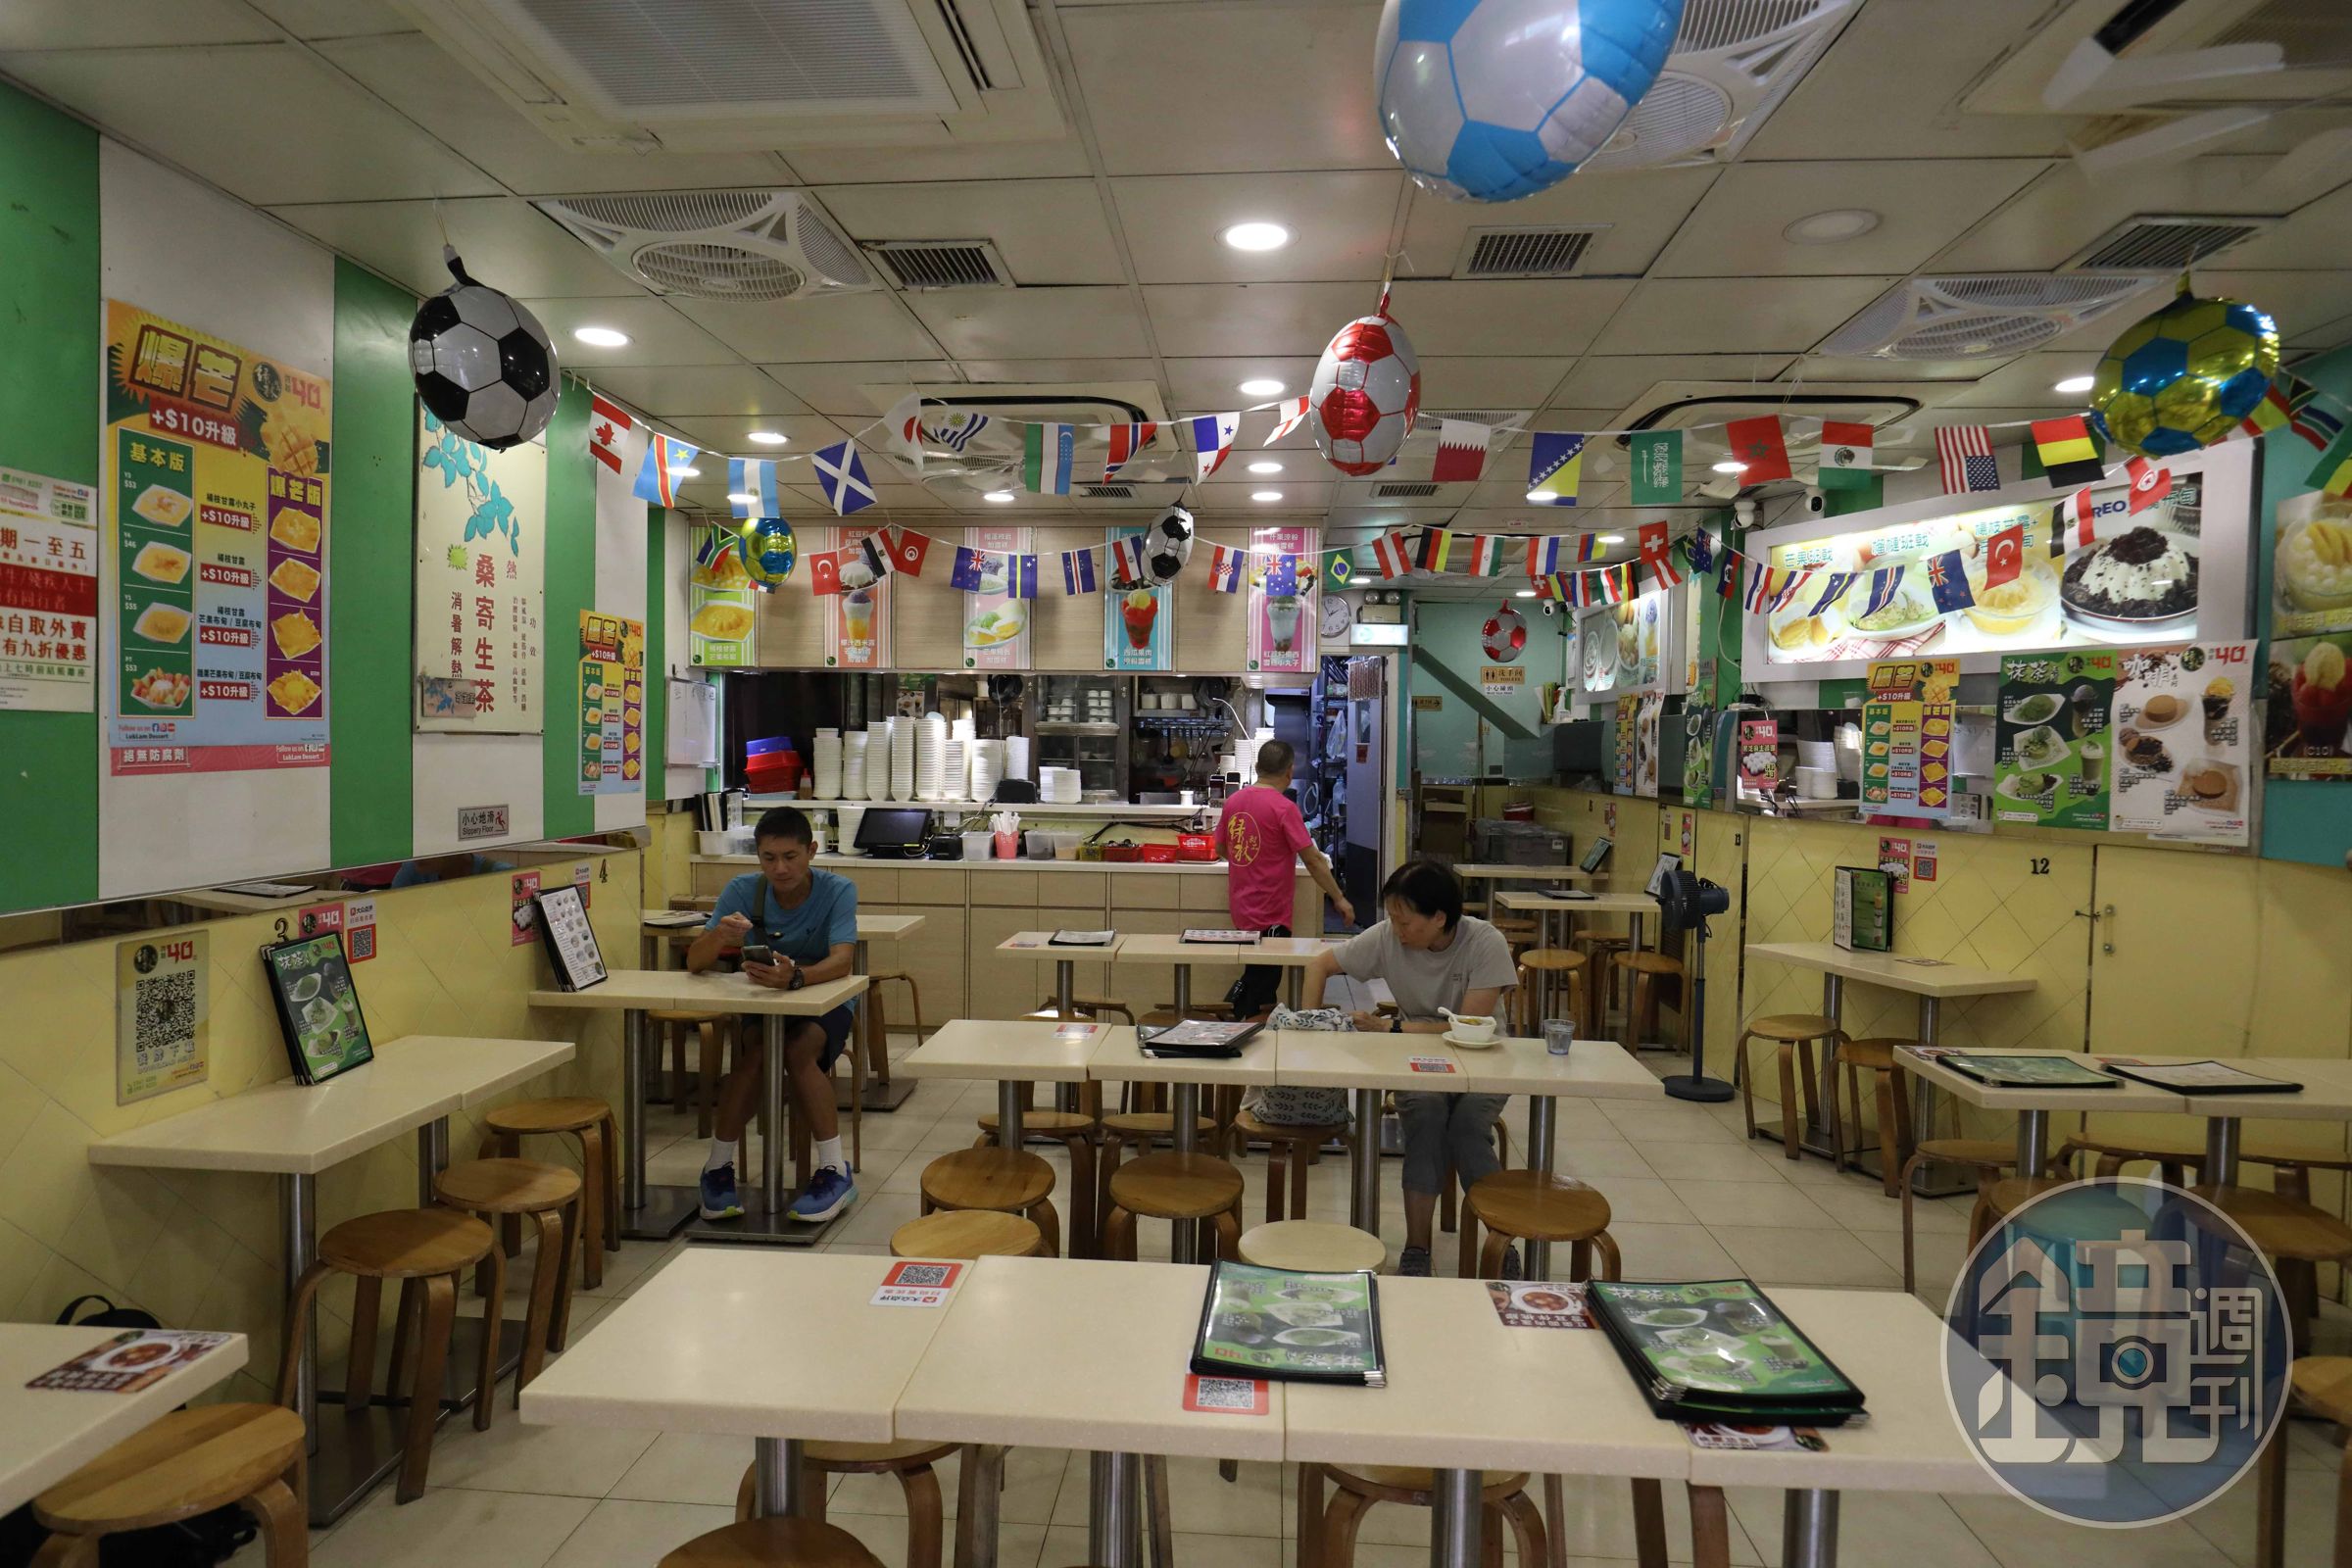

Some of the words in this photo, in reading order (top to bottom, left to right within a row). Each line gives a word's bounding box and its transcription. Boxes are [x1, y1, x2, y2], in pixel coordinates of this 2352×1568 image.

[129, 323, 241, 412] 爆芒
[291, 376, 321, 410] 40
[151, 409, 237, 446] +$10升級
[129, 442, 184, 472] 基本版
[202, 512, 249, 529] +$10升級
[217, 553, 245, 565] 楊枝甘露
[1785, 547, 1834, 568] 芒果班戟
[202, 568, 249, 585] +$10升級
[506, 561, 517, 580] 熱
[217, 606, 245, 617] 楊枝甘露
[201, 630, 249, 644] +$10升級
[451, 591, 463, 678] 消暑解熱
[474, 553, 495, 713] 桑寄生茶
[3, 638, 86, 661] 有九折優惠
[2215, 646, 2246, 665] 40
[2006, 660, 2049, 681] 抹茶
[2091, 657, 2111, 669] 40
[201, 687, 248, 699] +$10升級
[1758, 725, 1774, 738] 40
[463, 810, 494, 826] 小心地滑
[463, 825, 481, 836] Slippery
[599, 858, 608, 883] 4
[2031, 858, 2049, 874] 12
[167, 941, 192, 963] 40
